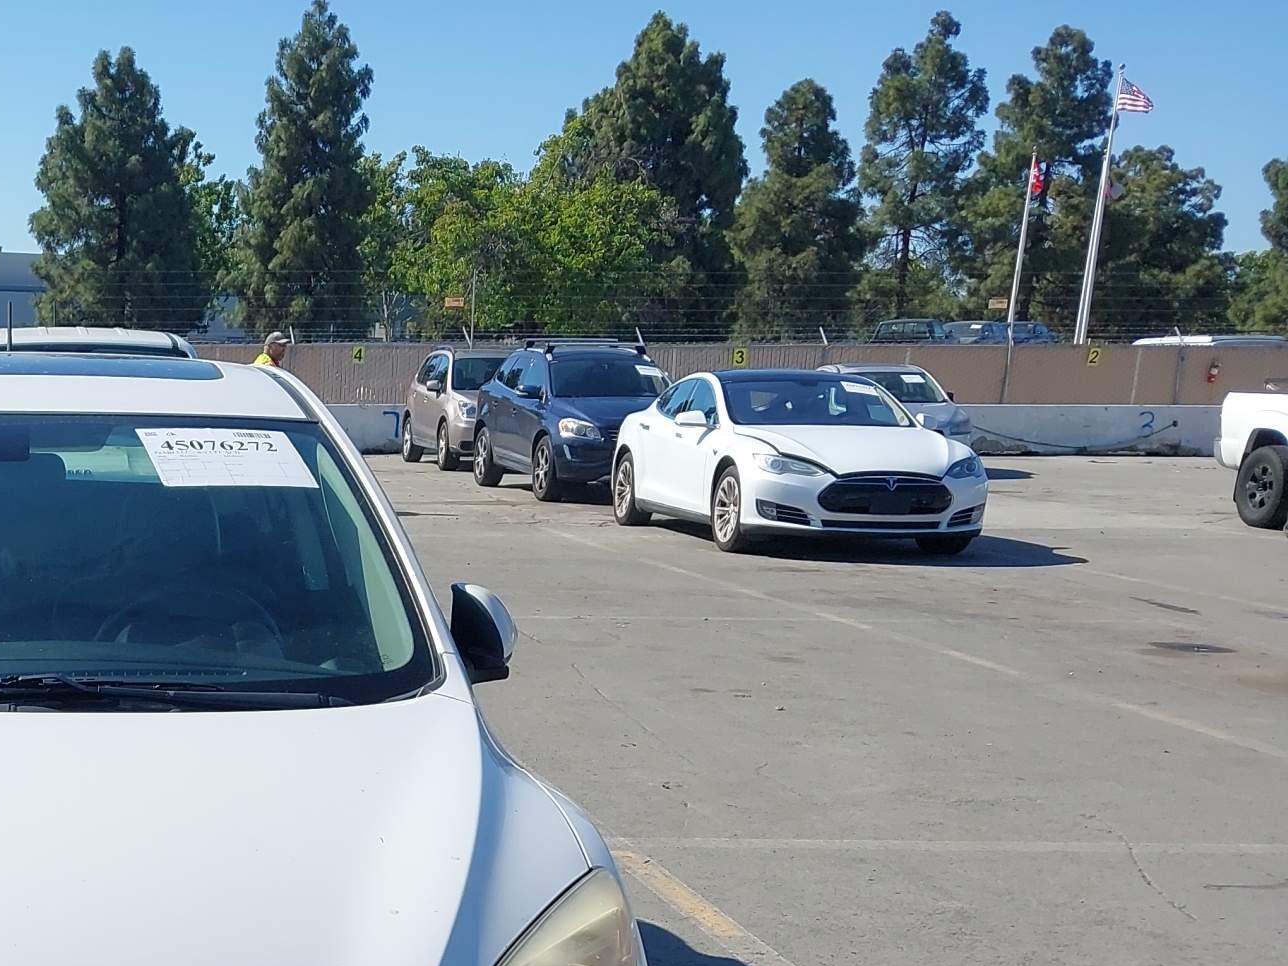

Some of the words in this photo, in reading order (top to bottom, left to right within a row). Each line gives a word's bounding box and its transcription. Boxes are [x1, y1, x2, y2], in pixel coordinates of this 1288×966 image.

[354, 348, 362, 362] 4
[735, 350, 745, 364] 3
[1088, 350, 1100, 364] 2
[160, 439, 278, 452] 45076272
